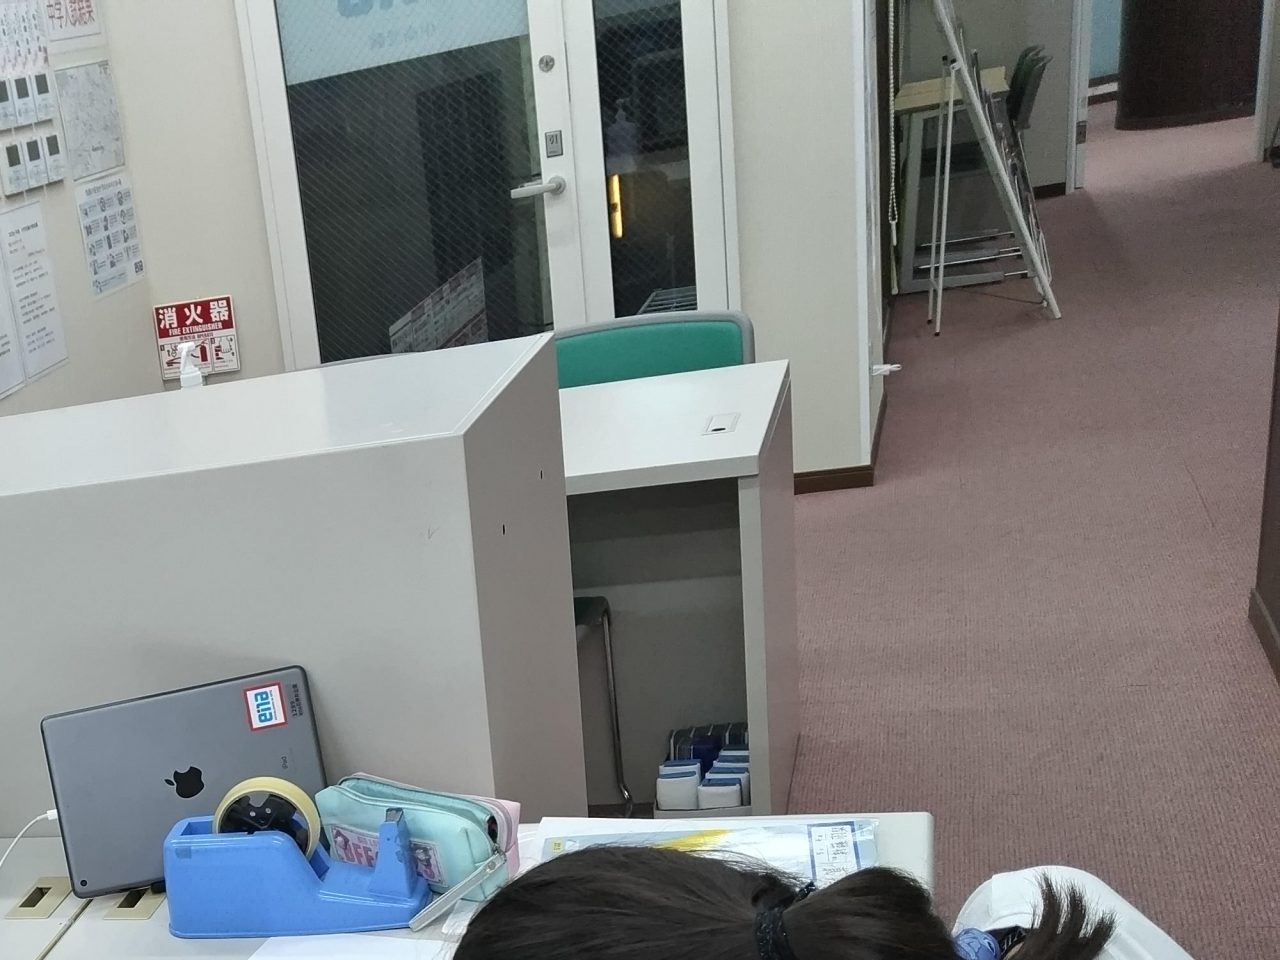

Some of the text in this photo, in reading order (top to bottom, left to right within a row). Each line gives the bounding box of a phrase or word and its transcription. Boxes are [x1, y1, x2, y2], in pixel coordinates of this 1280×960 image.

[158, 300, 229, 329] 消火器
[169, 322, 223, 336] FIRE EXTINGUISHER
[253, 690, 273, 723] ena
[280, 755, 288, 769] iPad
